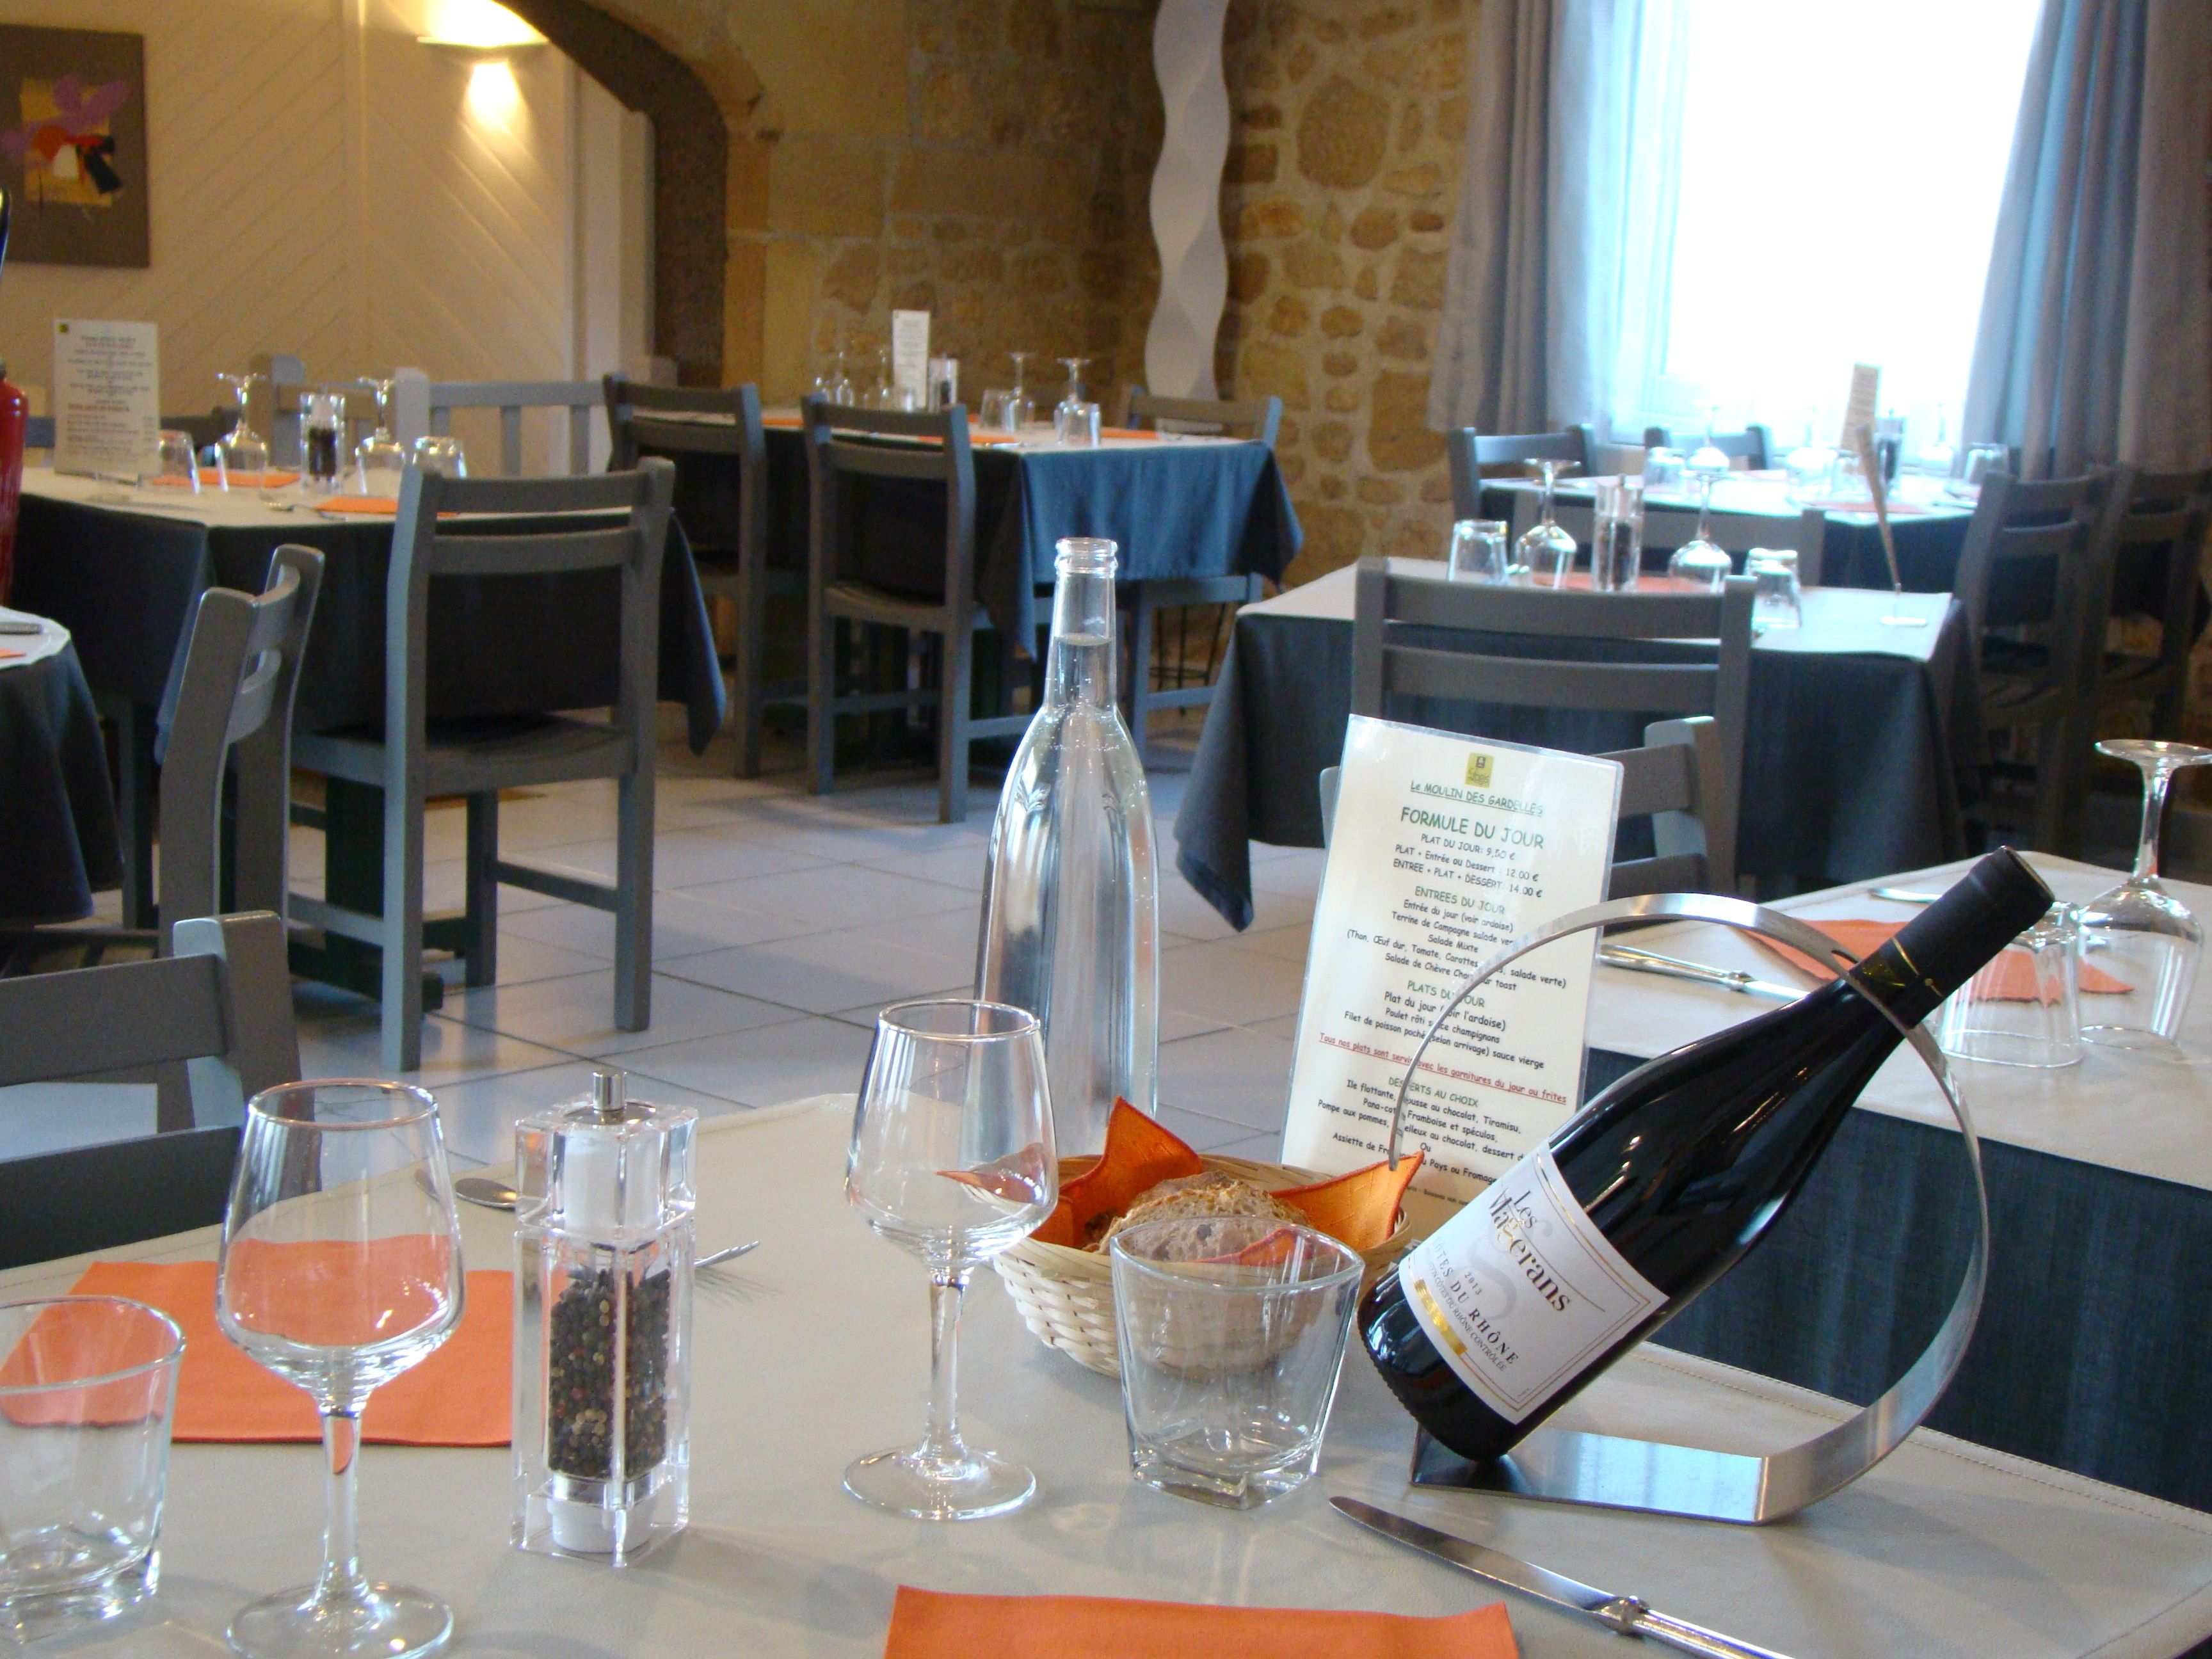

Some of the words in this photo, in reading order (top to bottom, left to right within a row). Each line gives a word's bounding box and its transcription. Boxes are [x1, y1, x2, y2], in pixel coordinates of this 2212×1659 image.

[1411, 780, 1420, 791] Le
[1424, 783, 1463, 799] MOULIN
[1466, 791, 1484, 803] DES
[1401, 806, 1469, 834] FORMULE
[1474, 822, 1496, 839] DU
[1501, 827, 1544, 849] JOUR
[1422, 833, 1441, 845] PLAT
[1444, 838, 1455, 848] DU
[1457, 844, 1483, 854] JOUR:
[1393, 858, 1423, 872] ENTREE
[1434, 867, 1454, 879] PLAT
[1395, 844, 1415, 855] PLAT
[1425, 851, 1450, 863] Entrée
[1466, 860, 1495, 873] Dessert
[1404, 899, 1428, 912] Entrée
[1431, 906, 1440, 915] du
[1443, 909, 1458, 919] jour
[1461, 913, 1479, 923] (voir
[1415, 886, 1457, 904] ENTREES
[1461, 897, 1475, 908] DU
[1478, 901, 1505, 915] JOUR
[1392, 911, 1418, 924] Terrine
[1422, 918, 1430, 927] de
[1434, 921, 1470, 937] Campagne
[1473, 931, 1497, 942] salade
[1501, 938, 1514, 946] ver
[1428, 934, 1453, 947] Salade
[1456, 941, 1479, 953] Mixte
[1347, 929, 1369, 942] (Thon,
[1393, 940, 1407, 951] dur,
[1412, 944, 1441, 959] Tomate,
[1445, 952, 1479, 968] Carottes
[1511, 969, 1536, 981] salade
[1540, 977, 1566, 988] verte)
[1385, 953, 1409, 965] Salade
[1413, 959, 1421, 968] de
[1425, 962, 1450, 975] Chèvre
[1454, 969, 1472, 979] Cha
[1496, 979, 1517, 991] toast
[1384, 991, 1401, 1004] Plat
[1405, 998, 1415, 1007] du
[1418, 1000, 1436, 1012] jour
[1440, 1006, 1460, 1018] (oir
[1464, 1011, 1506, 1031] l'ardoise)
[1407, 981, 1437, 996] PLATS
[1463, 995, 1485, 1007] OUR
[1344, 1011, 1361, 1022] Filet
[1364, 1017, 1372, 1025] de
[1375, 1022, 1402, 1033] poisson
[1454, 1041, 1489, 1057] arrivage)
[1493, 1050, 1514, 1061] sauce
[1519, 1057, 1544, 1069] vierge
[1386, 1007, 1408, 1020] Poulet
[1429, 1020, 1448, 1030] sce
[1452, 1027, 1500, 1043] champignons
[1320, 1032, 1335, 1044] Tous
[1353, 1043, 1370, 1053] plats
[1374, 1049, 1388, 1058] sont
[1437, 1063, 1448, 1074] les
[1451, 1069, 1491, 1085] garnitures
[1495, 1079, 1504, 1087] du
[1508, 1082, 1525, 1093] jour
[1541, 1089, 1567, 1103] frites
[1347, 1079, 1358, 1089] Ile
[1361, 1083, 1395, 1100] flottante,
[1407, 1097, 1427, 1109] ousse
[1443, 1107, 1479, 1123] chocolat,
[1484, 1116, 1521, 1134] Tiramisu,
[1388, 1077, 1431, 1095] DESERTS
[1436, 1090, 1447, 1099] AU
[1450, 1093, 1479, 1107] CHOIX
[1318, 1099, 1340, 1112] Pompe
[1343, 1109, 1356, 1117] aux
[1358, 1112, 1389, 1128] pommes,
[1404, 1126, 1427, 1137] elleux
[1442, 1136, 1478, 1151] chocolat,
[1482, 1145, 1514, 1160] dessert
[1363, 1098, 1396, 1114] Pana-cot
[1407, 1110, 1447, 1128] Framboise
[1462, 1126, 1498, 1142] spéculos,
[1333, 1132, 1363, 1147] Assiette
[1366, 1141, 1375, 1150] de
[1429, 1158, 1448, 1172] Pays
[1420, 1142, 1431, 1152] Ou
[1514, 1190, 1536, 1229] Les
[1464, 1271, 1482, 1295] 2013
[1450, 1280, 1470, 1303] DU
[1469, 1308, 1518, 1364] RHÔNE
